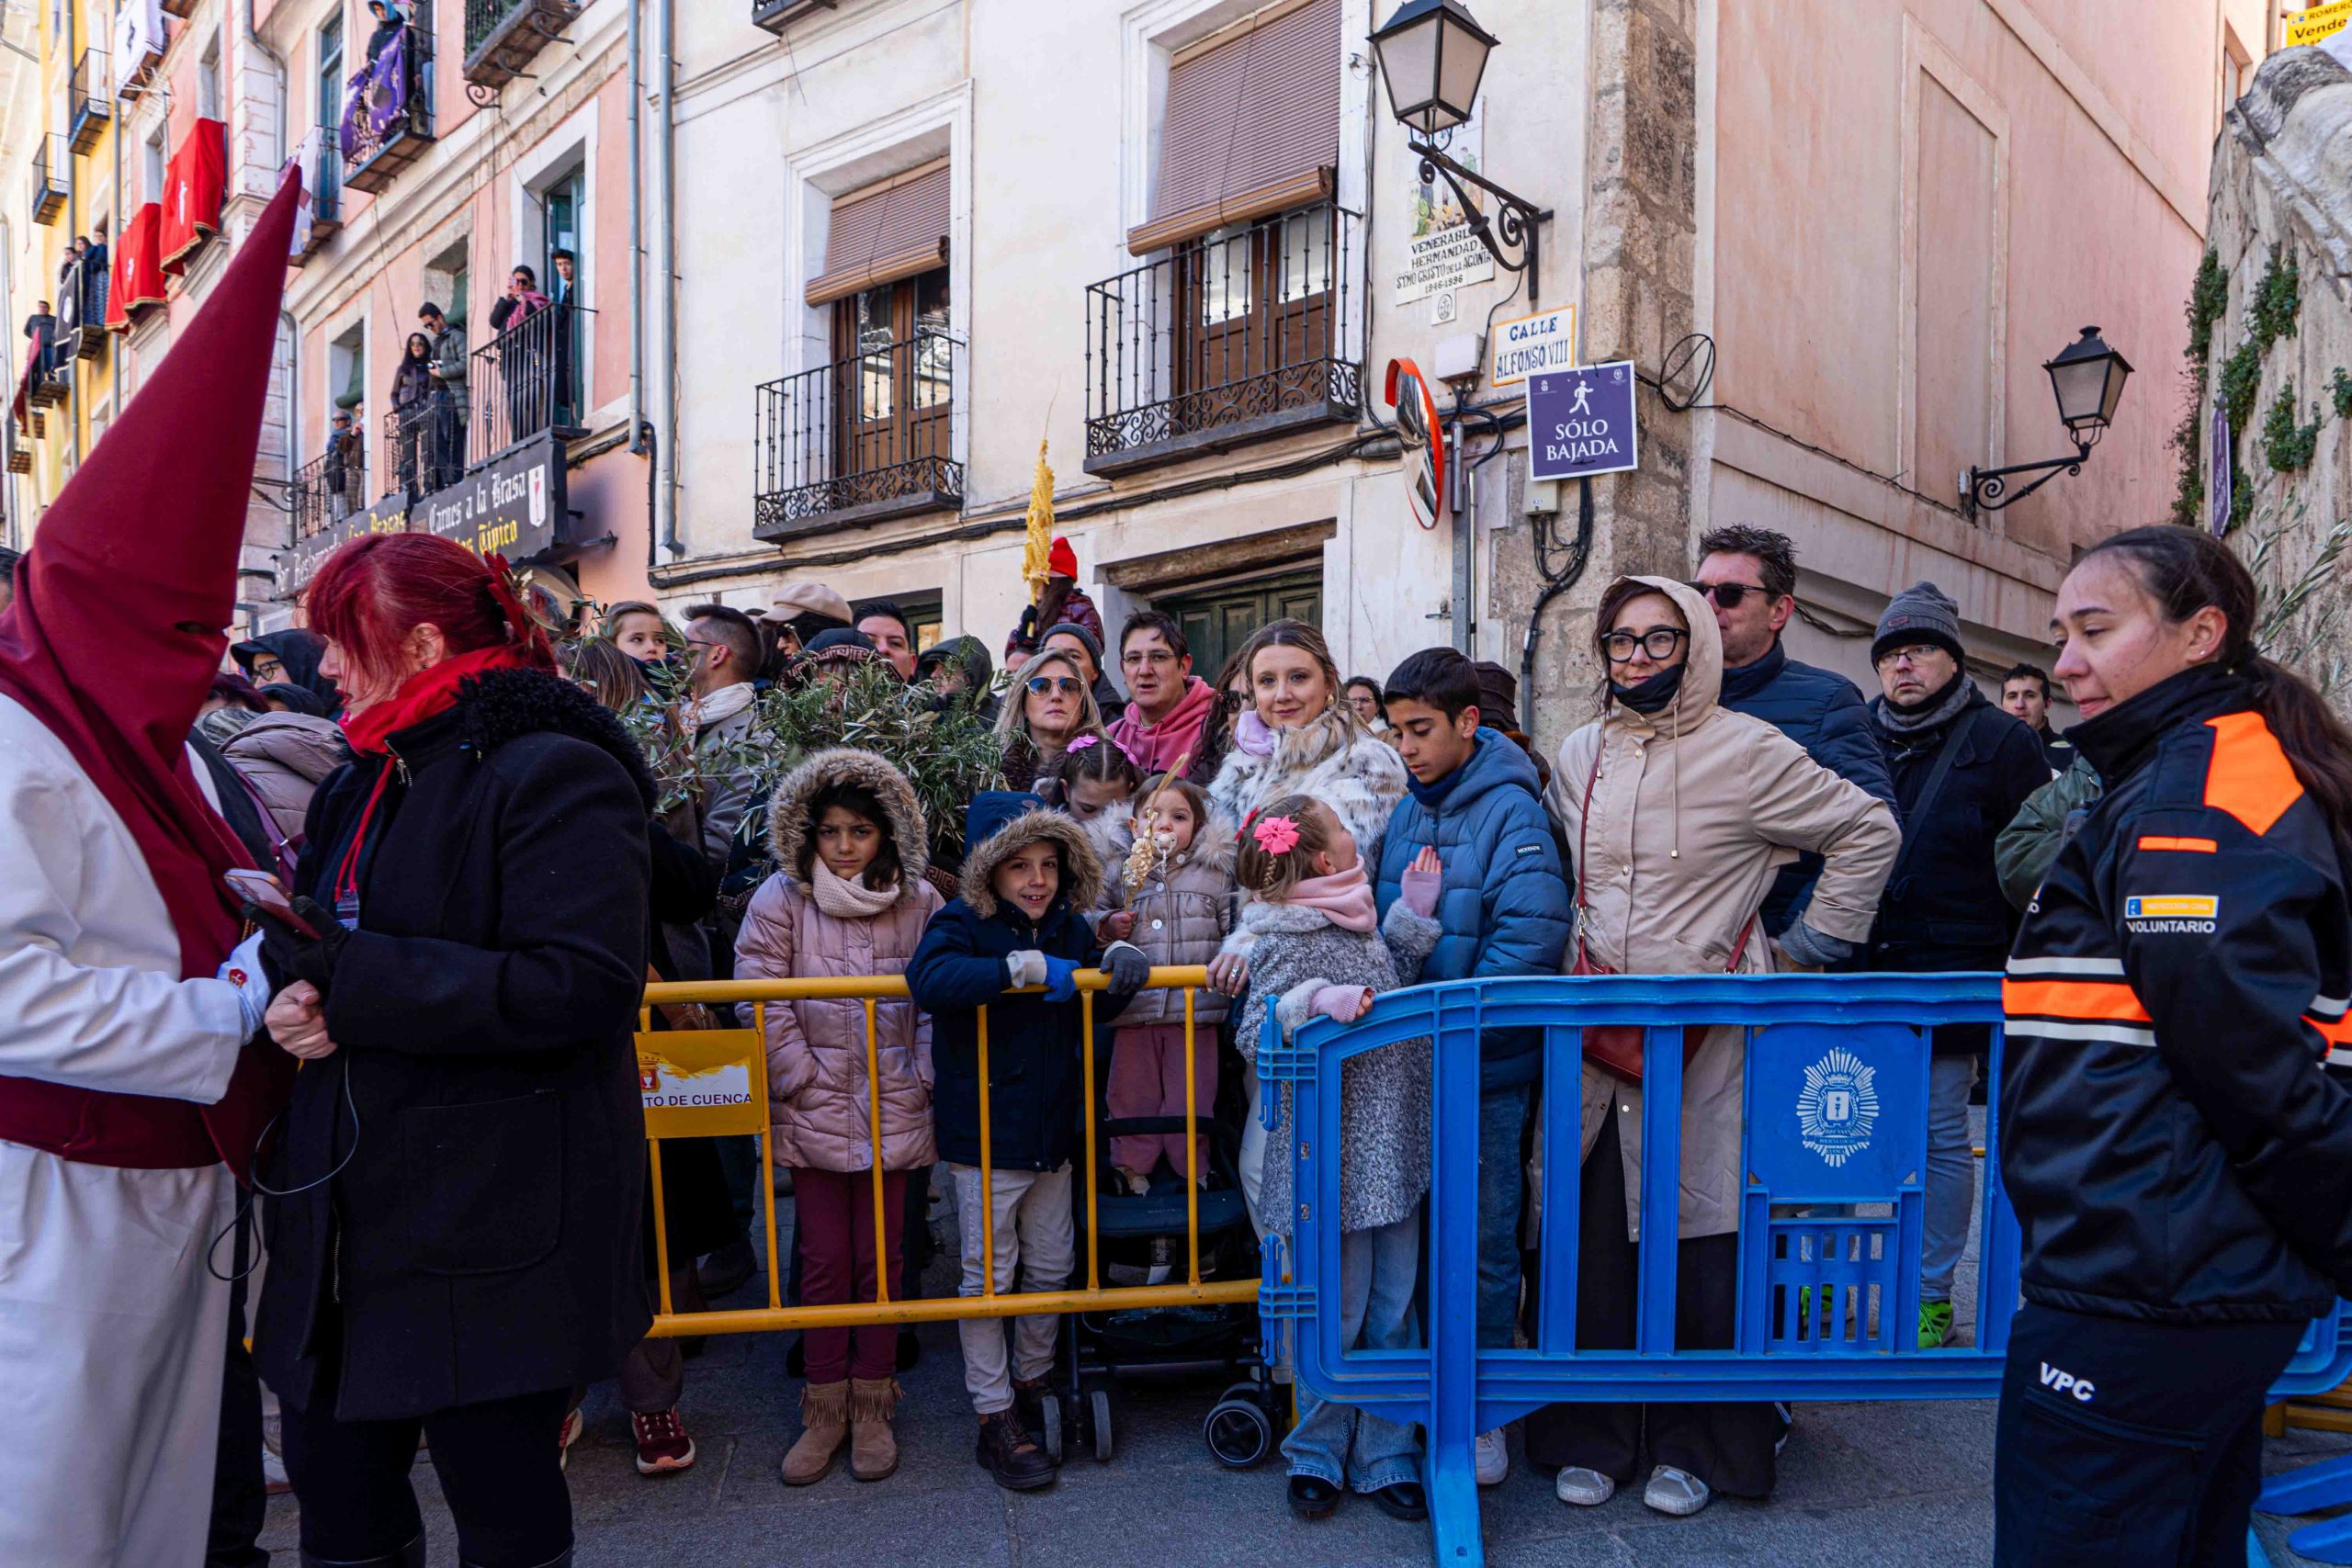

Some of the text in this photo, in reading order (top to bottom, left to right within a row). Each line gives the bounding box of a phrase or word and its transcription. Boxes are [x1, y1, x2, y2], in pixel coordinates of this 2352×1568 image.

[1411, 228, 1475, 255] VENERABL
[1411, 240, 1478, 269] HERMANDAD
[1418, 264, 1446, 284] CRISTO
[1510, 315, 1558, 343] CALLE
[1496, 338, 1569, 380] ALFONSO VIII
[1555, 418, 1609, 441] SÓLO
[1545, 438, 1620, 464] BAJADA
[429, 471, 526, 536] Carnes a la Brasa
[2126, 919, 2216, 934] VOLUNTARIO
[645, 1093, 752, 1108] TO DE CUENCA
[2040, 1360, 2096, 1402] VPC
